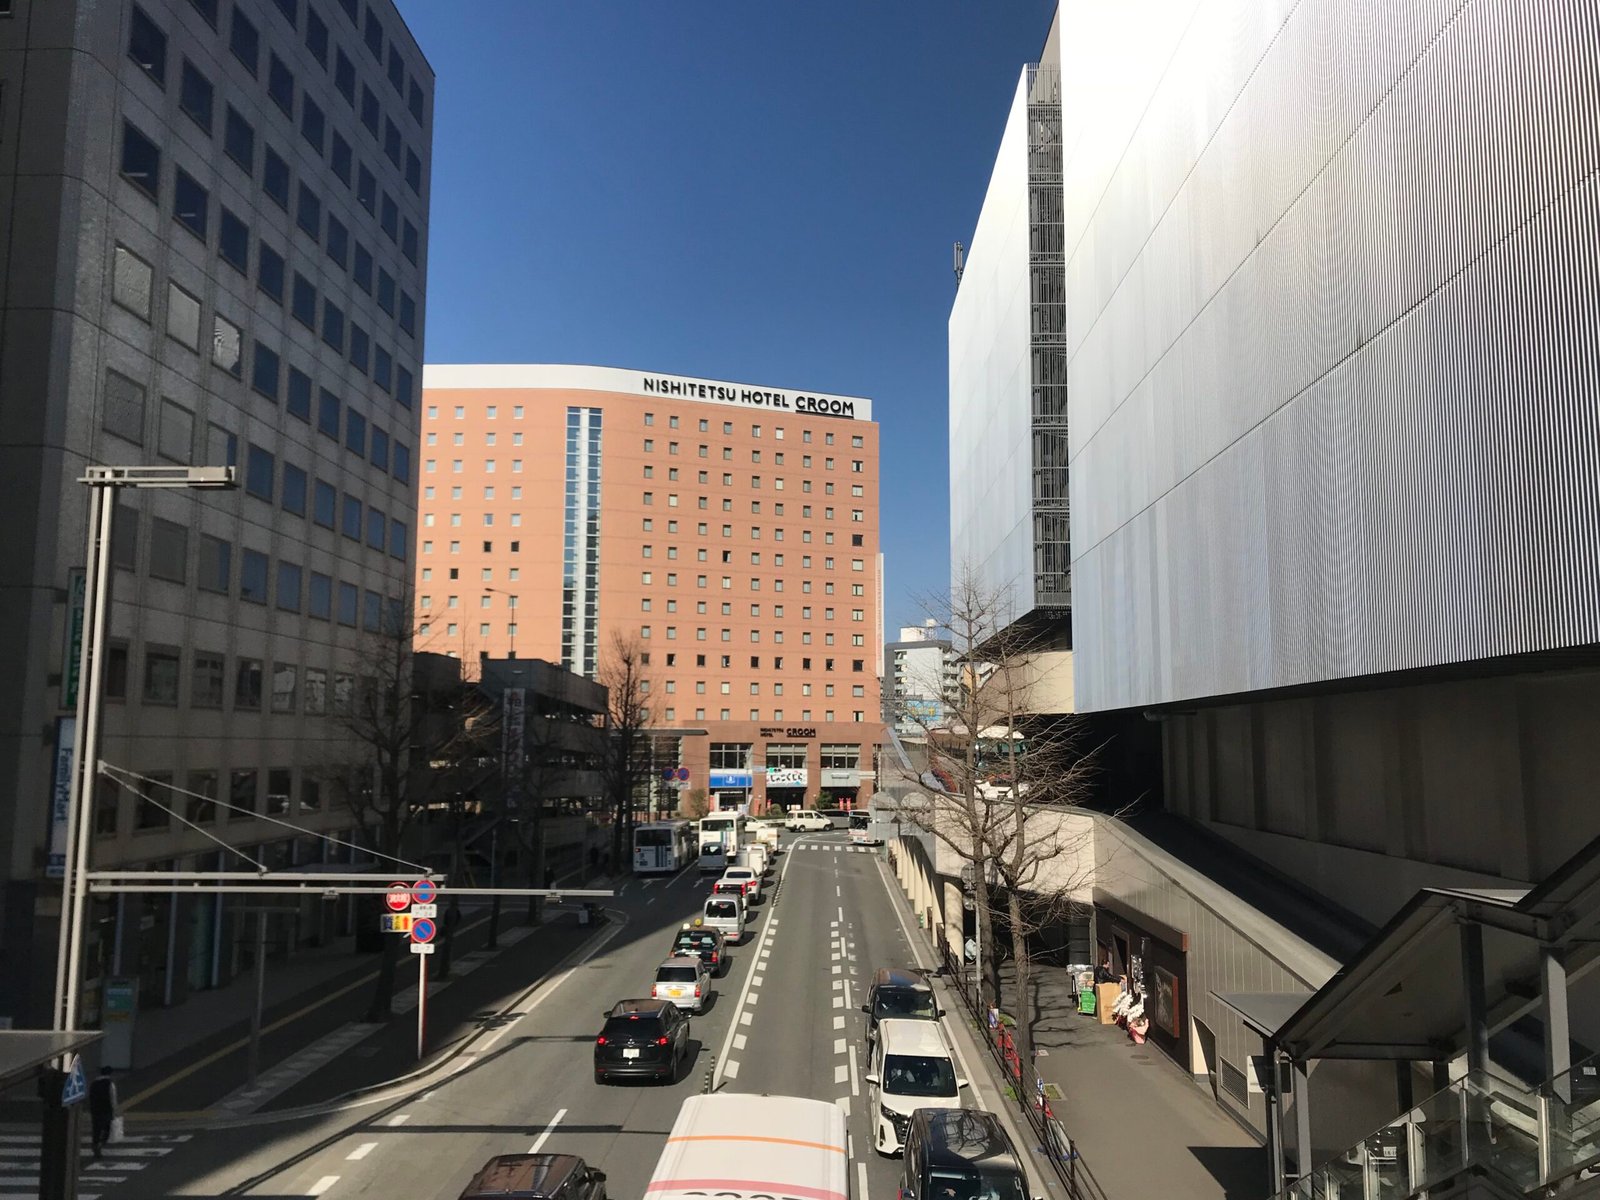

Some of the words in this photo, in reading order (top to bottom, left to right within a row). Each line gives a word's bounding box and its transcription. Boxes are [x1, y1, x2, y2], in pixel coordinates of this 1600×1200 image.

[643, 378, 736, 400] NISHITETSU
[741, 390, 789, 409] HOTEL
[795, 397, 854, 418] CROOM
[56, 748, 74, 821] FamilyMart
